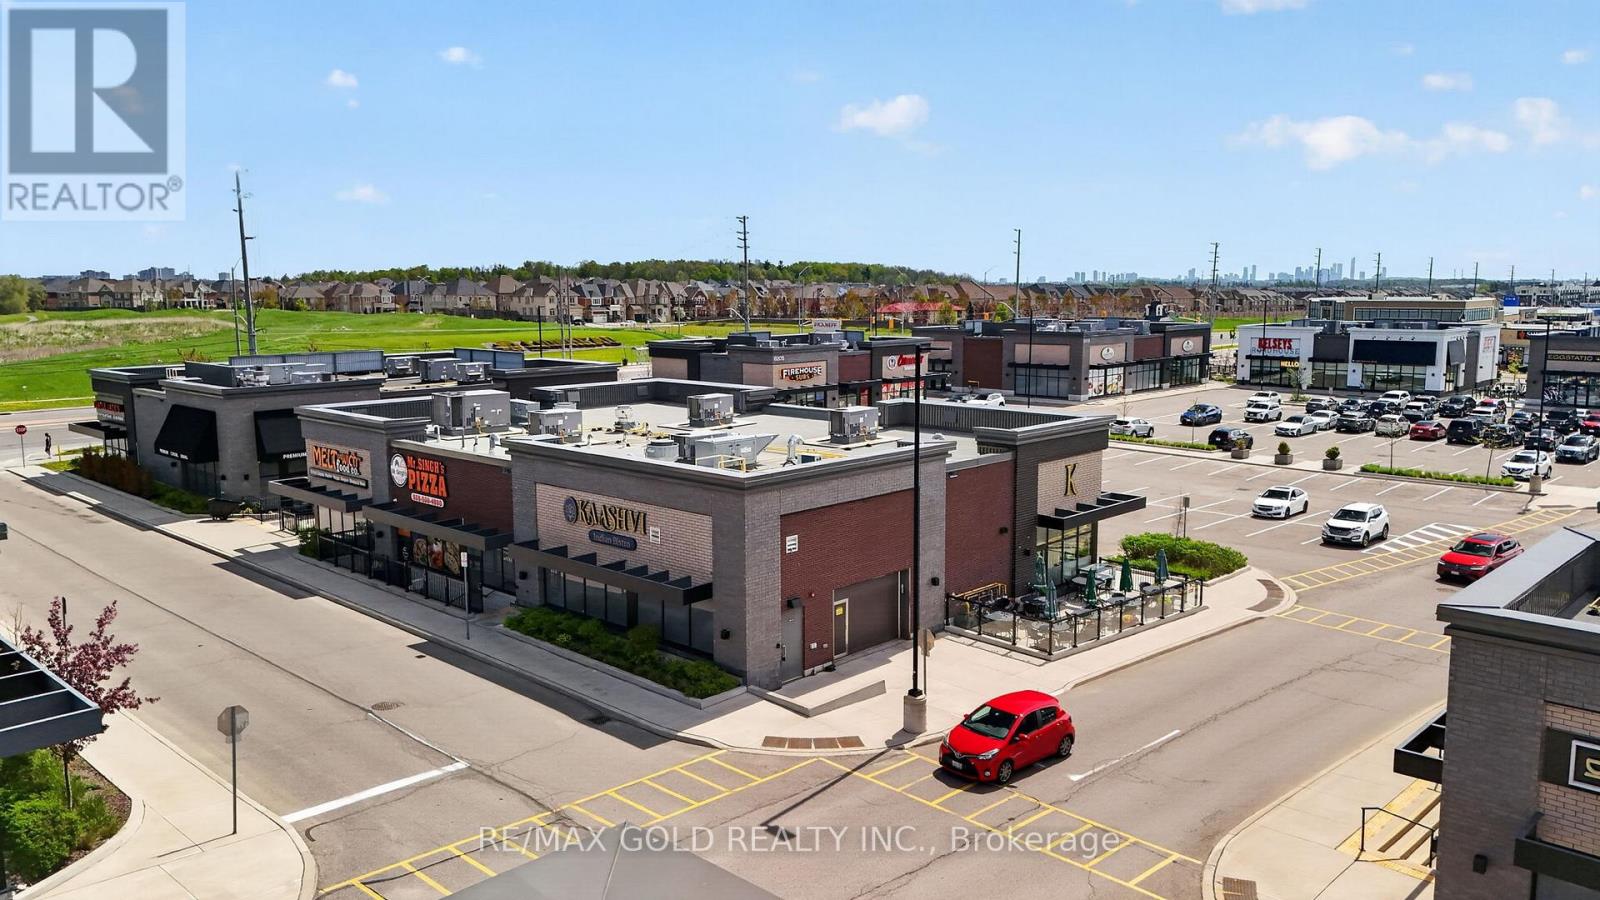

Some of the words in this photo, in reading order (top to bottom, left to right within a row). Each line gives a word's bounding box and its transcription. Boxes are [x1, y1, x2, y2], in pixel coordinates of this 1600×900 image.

[782, 366, 823, 379] FIREHOUSE
[408, 468, 447, 497] PIZZA
[1064, 462, 1078, 496] K
[578, 499, 647, 536] KAASHVI
[593, 532, 612, 544] Indian
[612, 536, 631, 549] Bistro
